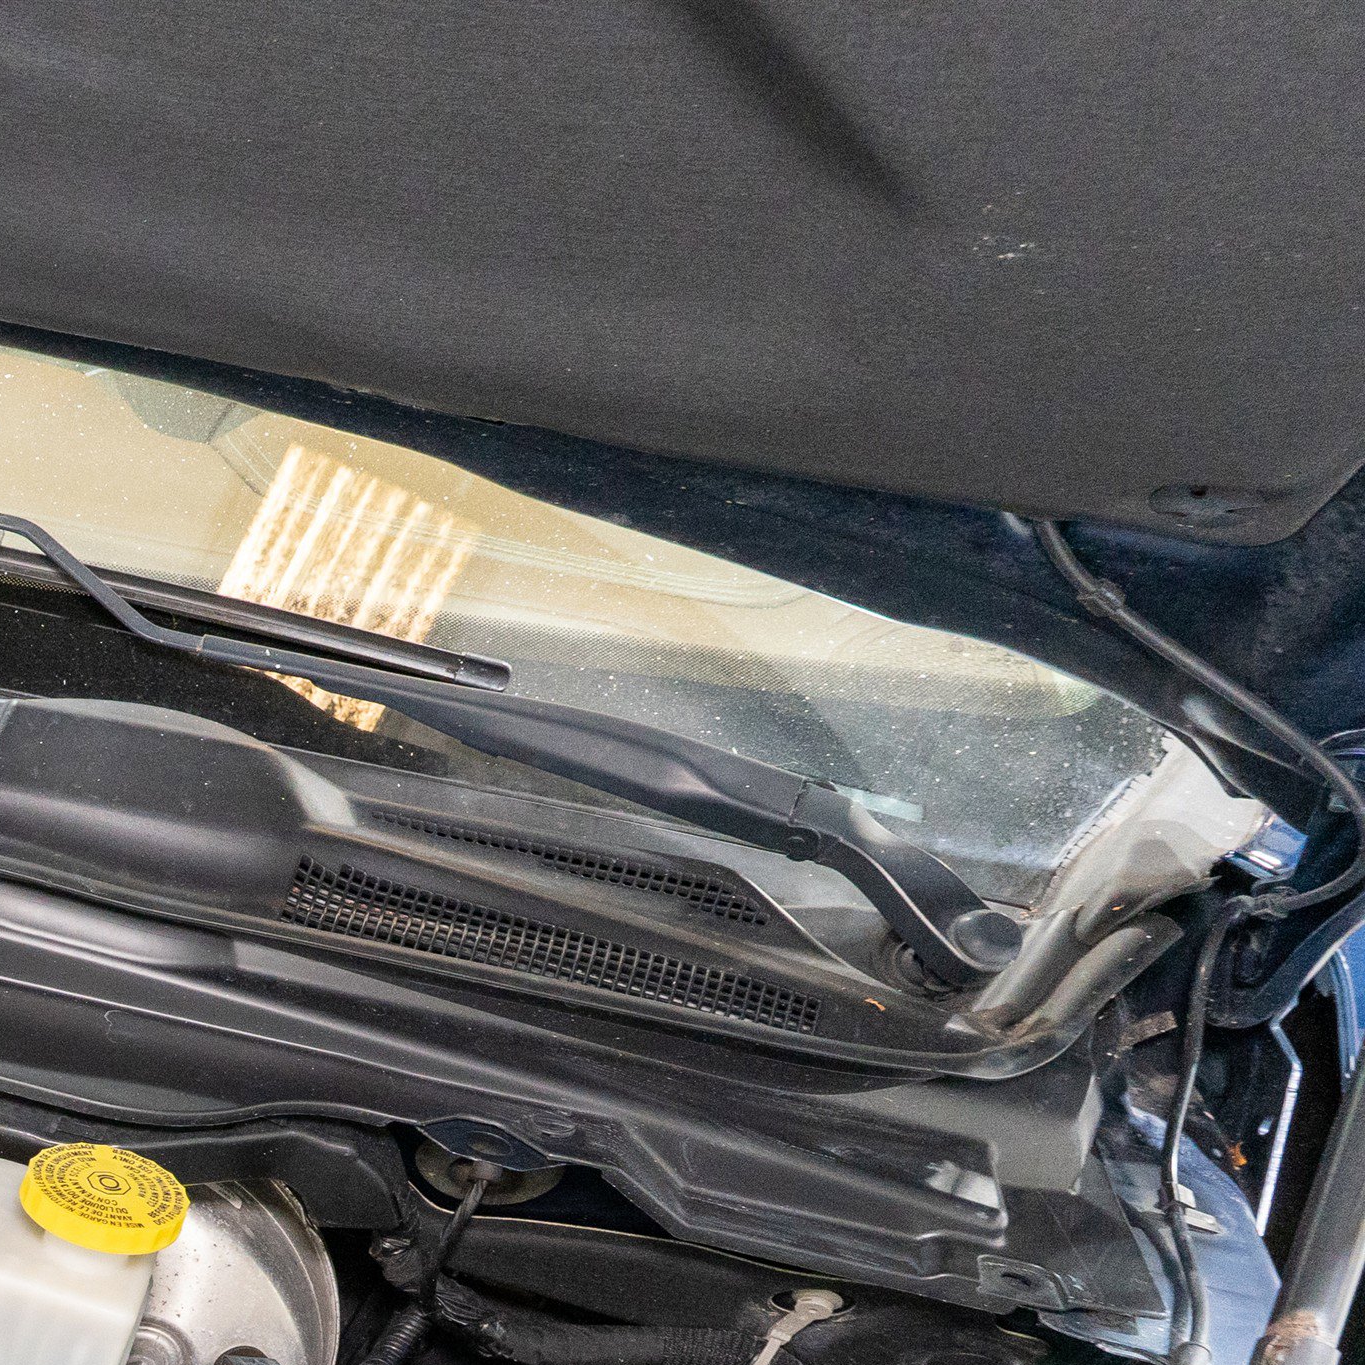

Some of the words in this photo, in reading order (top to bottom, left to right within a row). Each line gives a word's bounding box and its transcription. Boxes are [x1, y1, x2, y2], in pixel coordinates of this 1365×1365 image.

[112, 1149, 156, 1168] CONTAINER
[113, 1155, 135, 1165] ONLY
[79, 1199, 114, 1212] LIQUIDE
